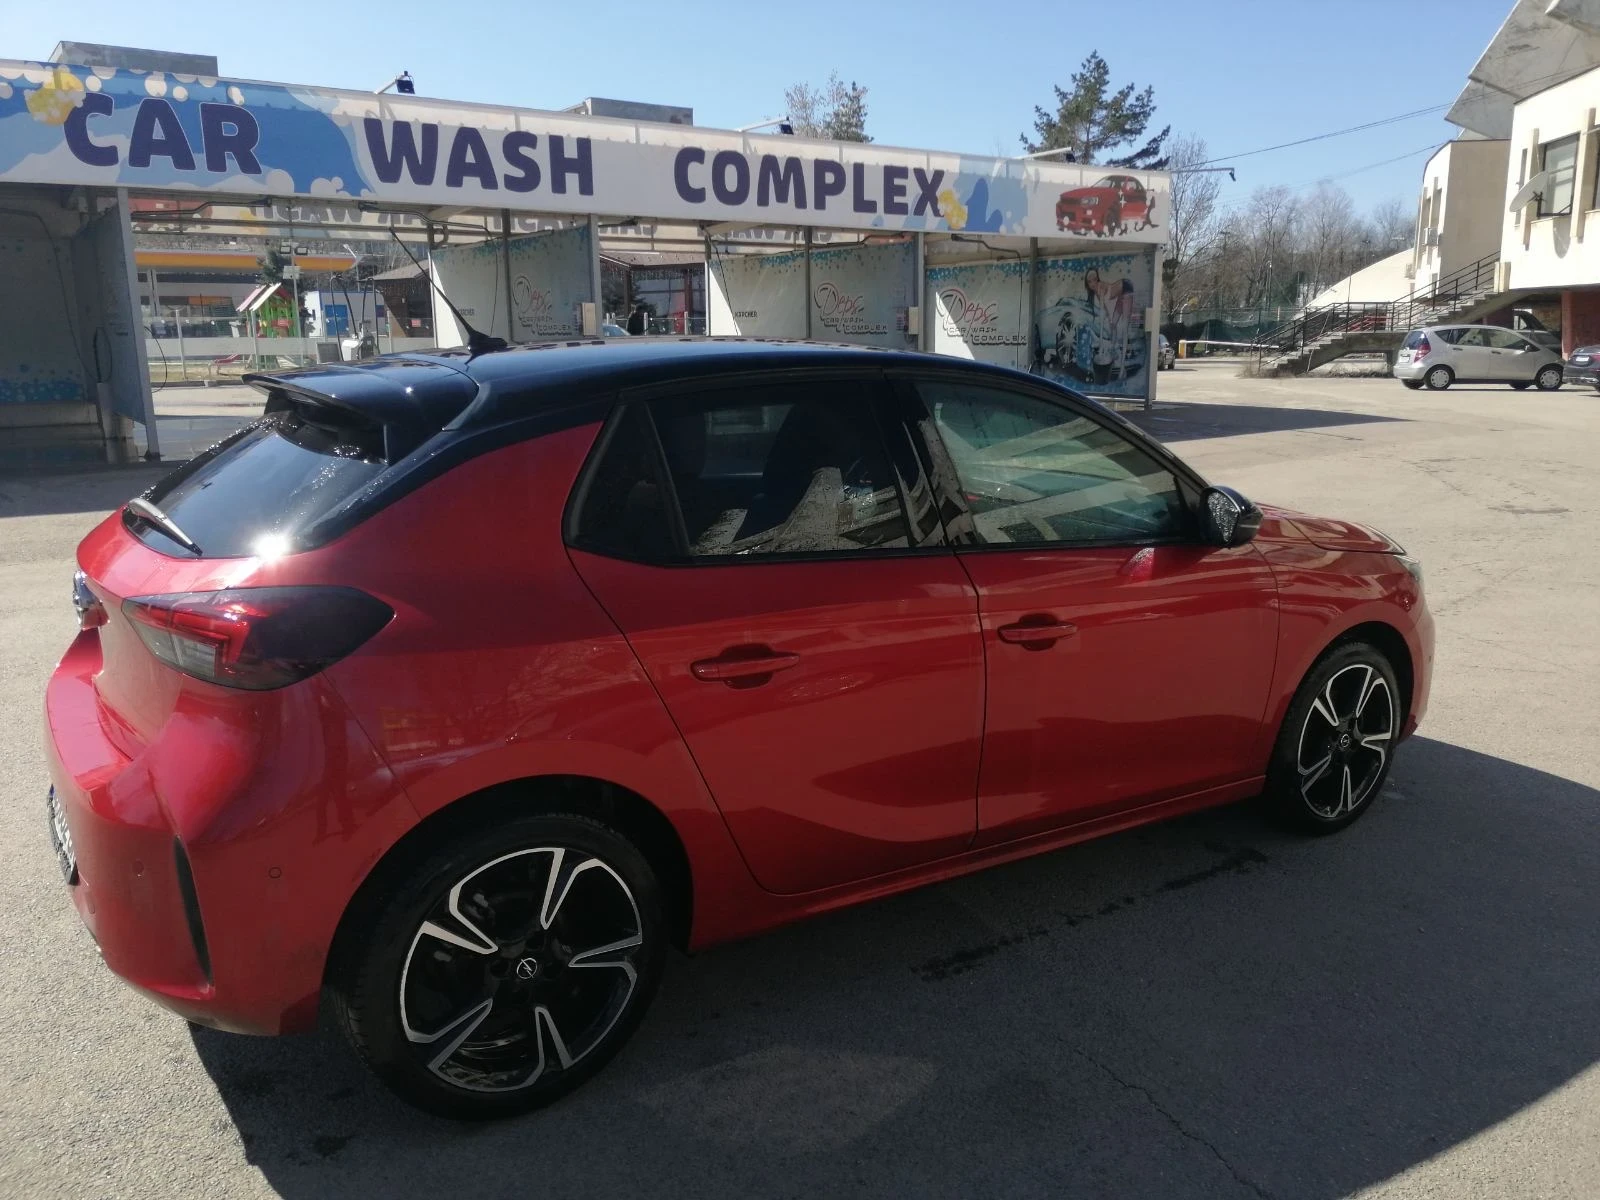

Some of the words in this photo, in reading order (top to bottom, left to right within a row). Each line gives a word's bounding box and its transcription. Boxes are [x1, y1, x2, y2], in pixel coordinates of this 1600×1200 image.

[63, 92, 263, 175] CAR
[363, 117, 594, 196] WASH
[673, 146, 945, 218] COMPLEX
[972, 334, 1027, 344] COMPLEX
